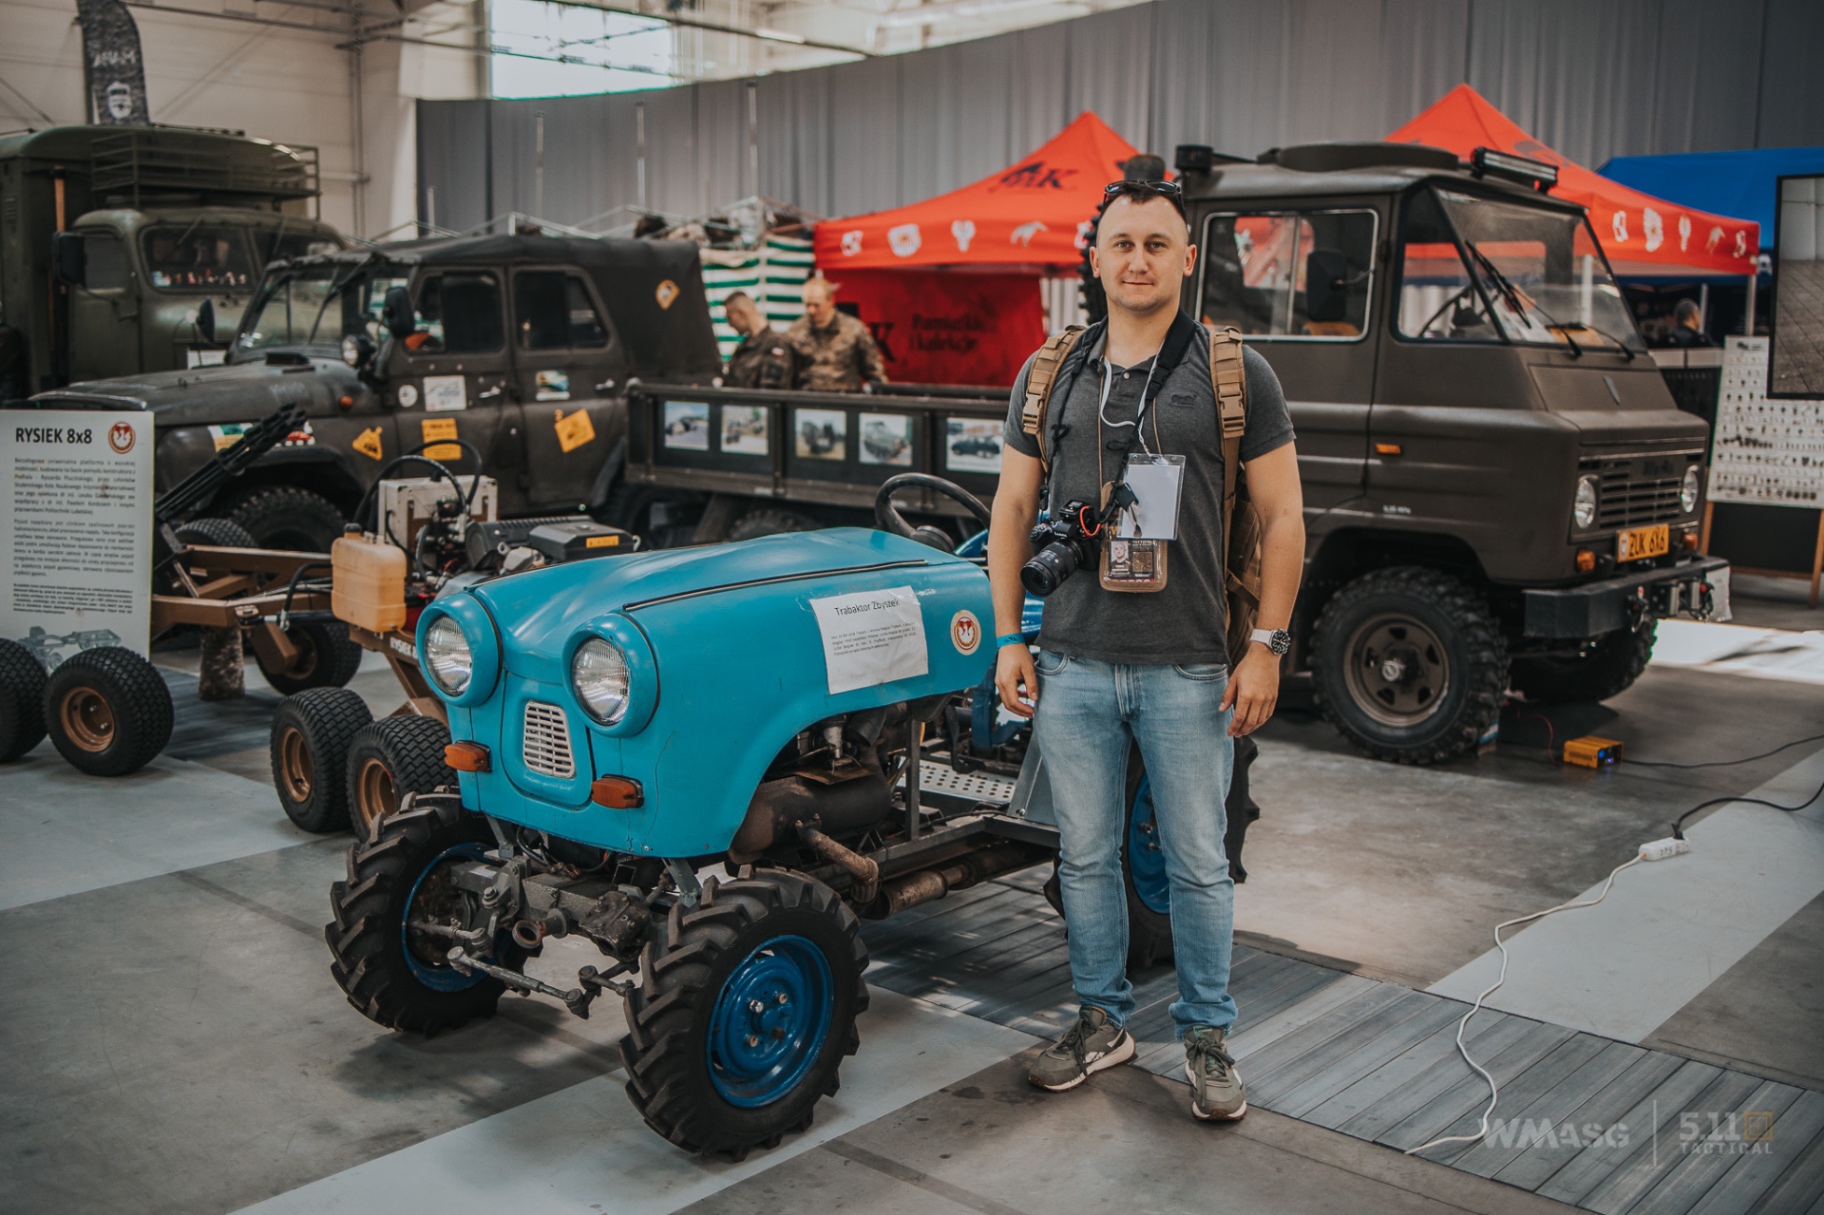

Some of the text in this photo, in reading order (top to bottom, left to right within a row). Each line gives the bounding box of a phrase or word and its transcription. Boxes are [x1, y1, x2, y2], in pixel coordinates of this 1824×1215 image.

[15, 427, 92, 444] RYSIEK 8x8
[834, 598, 900, 616] Trabaktor Zbyszek
